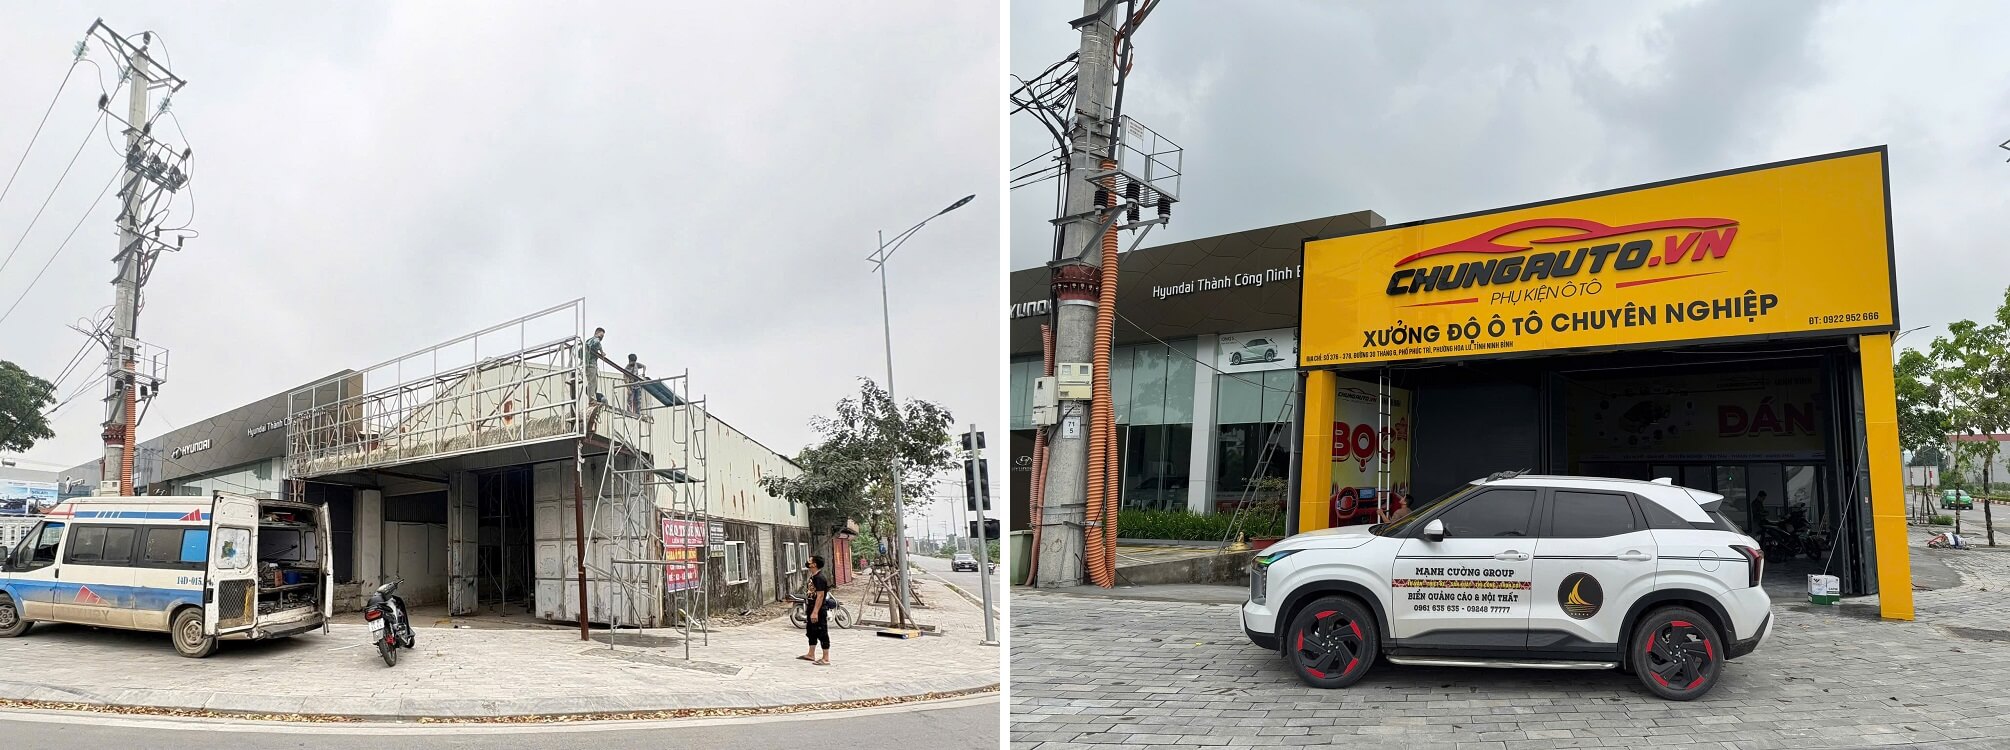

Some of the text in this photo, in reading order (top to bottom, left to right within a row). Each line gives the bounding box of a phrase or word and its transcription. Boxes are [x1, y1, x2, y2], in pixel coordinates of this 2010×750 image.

[1386, 226, 1738, 296] CHUNGAUTO.VN
[1152, 283, 1194, 300] Hyundai
[1198, 276, 1231, 291] Thành
[1234, 270, 1263, 288] Công
[1266, 267, 1293, 283] Ninh
[1490, 277, 1602, 306] PHỤ KIỆN Ô TÔ
[1363, 289, 1778, 349] XƯỞNG ĐỘ Ô TÔ CHUYÊN NGHIỆP
[1809, 311, 1879, 325] ĐT: 0922 952 666
[1377, 349, 1392, 357] THÁNG
[1409, 346, 1421, 354] PHÚC
[1433, 344, 1453, 353] PHƯỜNG
[1454, 344, 1464, 352] HOA
[1487, 341, 1499, 350] NINH
[1500, 340, 1514, 349] BÌNH
[1718, 396, 1816, 439] DÁN
[182, 438, 211, 455] HYUNDAI
[1332, 421, 1396, 472] BỌC
[1415, 566, 1515, 578] MẠNH CƯỜNG GROUP
[1408, 589, 1425, 601] BIỂN
[1427, 590, 1455, 602] QUẢNG
[1456, 591, 1473, 602] CÁO
[1481, 592, 1495, 604] NỘI
[1497, 591, 1519, 602] THẤT
[1413, 604, 1430, 612] 0961
[1432, 604, 1445, 612] 635
[1466, 605, 1488, 613] 09248
[1490, 605, 1511, 614] 77777
